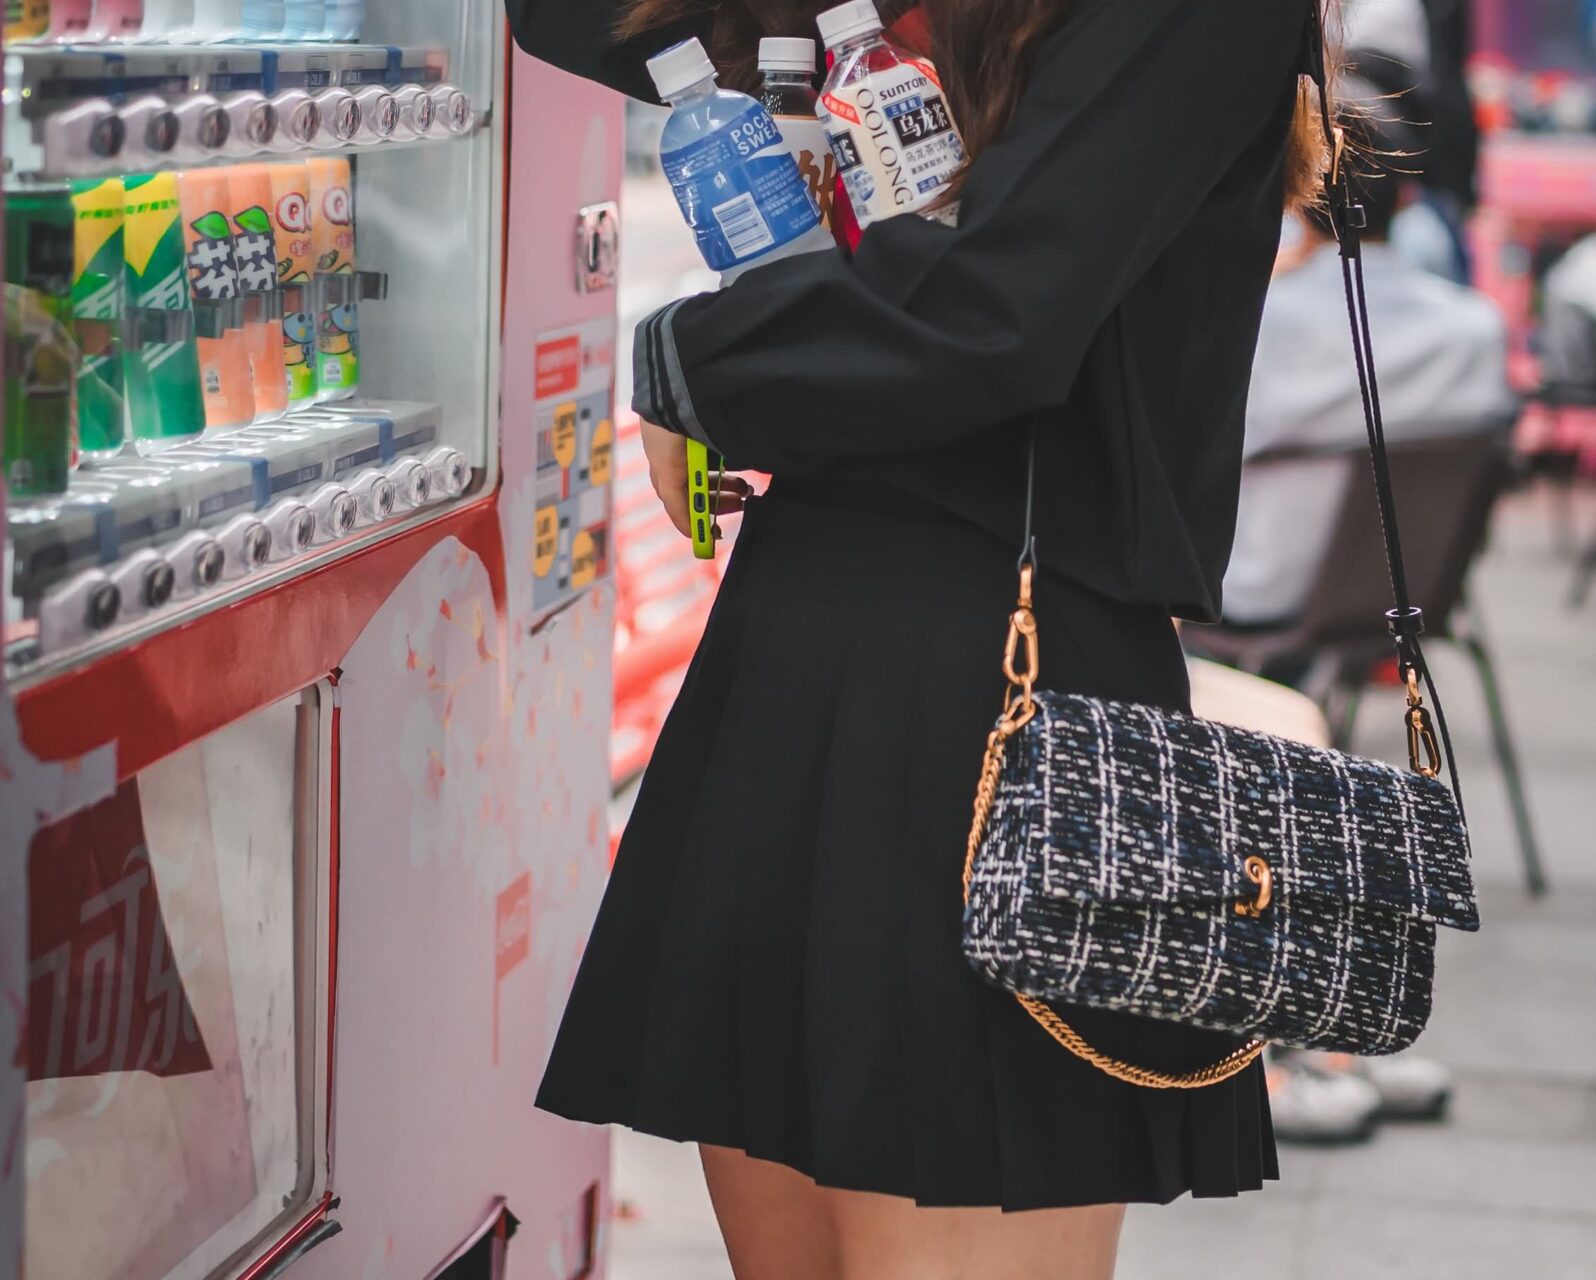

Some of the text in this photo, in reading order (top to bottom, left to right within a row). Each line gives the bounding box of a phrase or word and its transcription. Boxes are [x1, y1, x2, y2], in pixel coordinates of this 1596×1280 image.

[879, 76, 928, 101] SUNTORY
[900, 102, 948, 138] 乌龙茶
[856, 87, 914, 207] OOLONG
